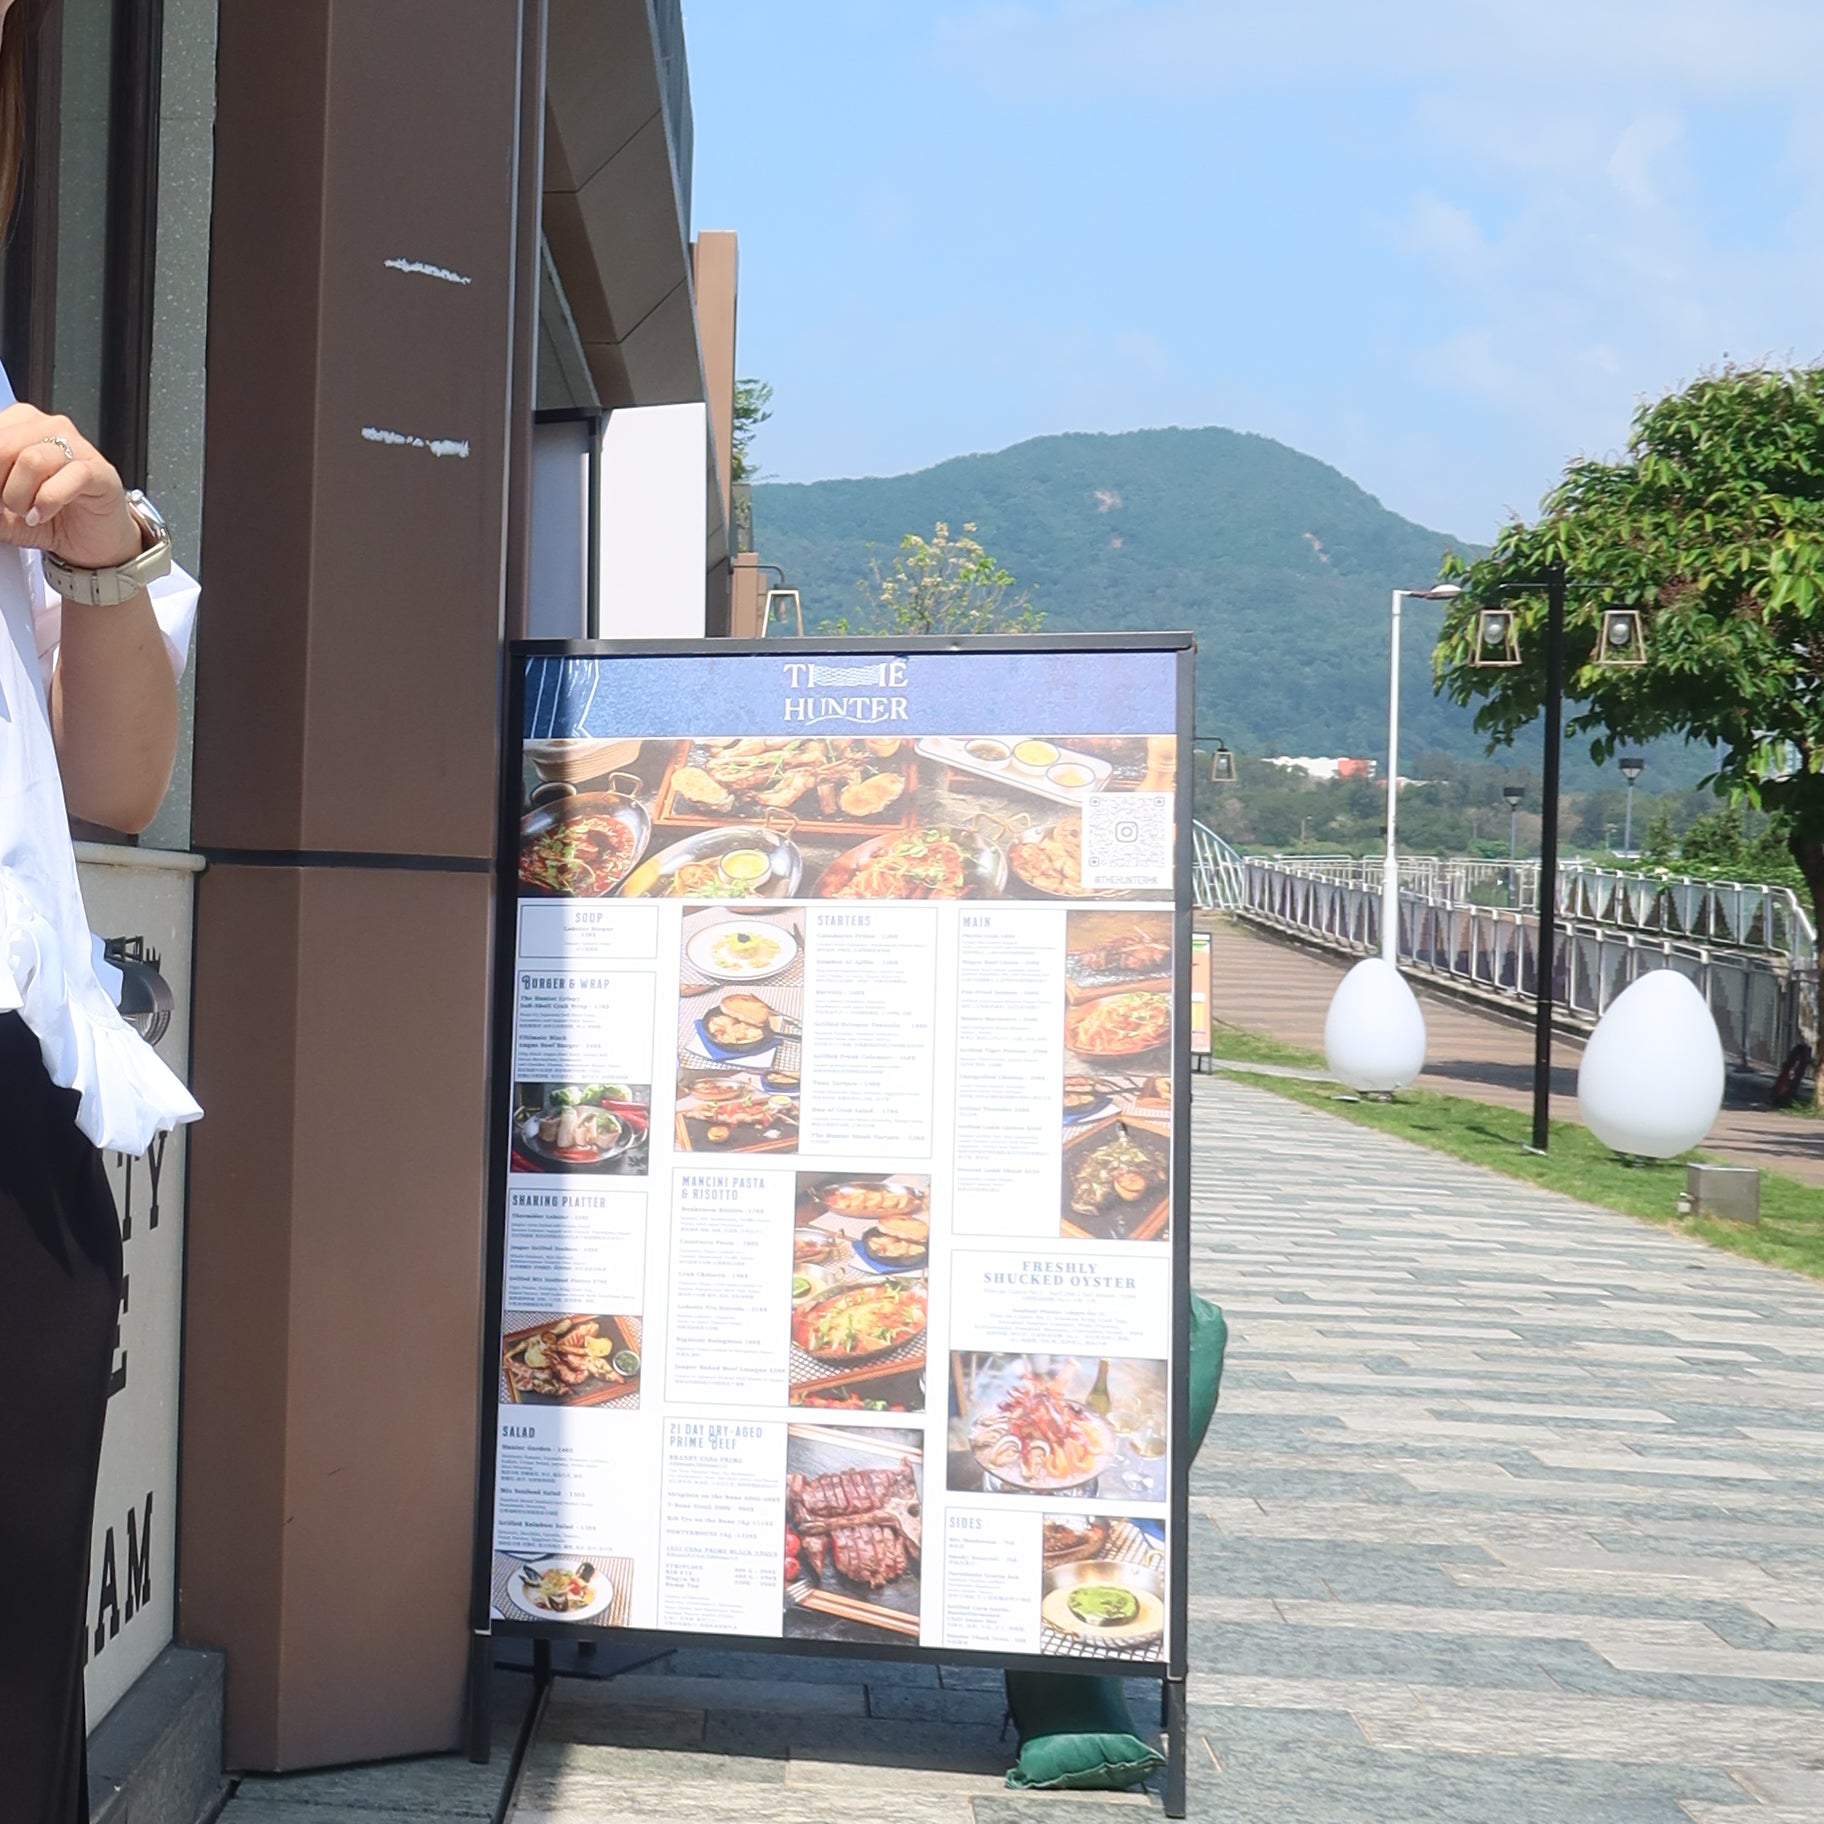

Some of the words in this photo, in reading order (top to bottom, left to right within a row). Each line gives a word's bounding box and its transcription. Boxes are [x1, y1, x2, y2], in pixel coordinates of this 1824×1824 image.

[783, 697, 909, 721] HUNTER
[575, 912, 603, 923] SOUP
[817, 915, 871, 926] STARTERS
[963, 916, 991, 928] MAIN
[521, 975, 565, 990] BURGER
[569, 978, 575, 989] &
[580, 979, 610, 990] WRAP
[682, 1176, 729, 1188] MANCINI
[732, 1177, 765, 1189] PASTA
[681, 1189, 688, 1199] &
[693, 1189, 738, 1200] RISOTTO
[512, 1195, 558, 1207] SHARING
[562, 1196, 606, 1208] PLATTER
[1022, 1261, 1098, 1274] FRESHLY
[983, 1272, 1064, 1285] SHUCKED
[1070, 1275, 1136, 1289] OYSTER
[502, 1425, 535, 1438] SALAD
[670, 1423, 681, 1434] 21
[685, 1424, 705, 1435] DAY
[709, 1425, 763, 1438] DRY-AGED
[670, 1436, 704, 1448] PRIME
[709, 1435, 737, 1450] BEEF
[949, 1516, 982, 1529] SIDES
